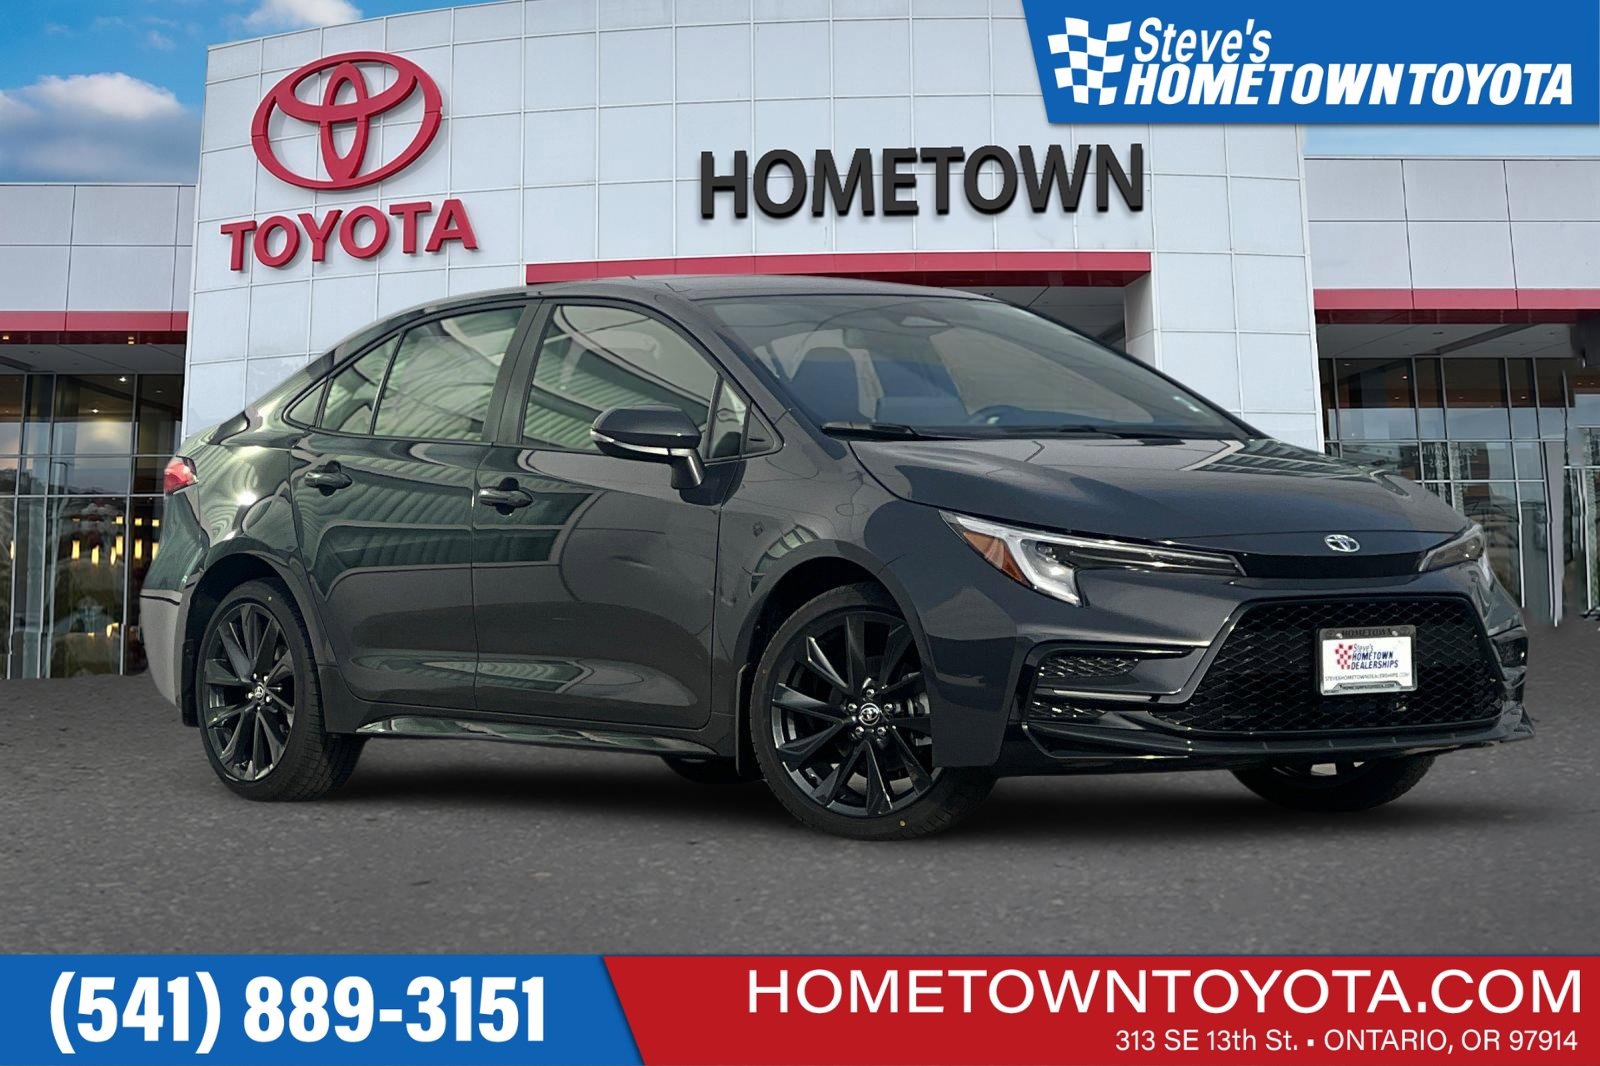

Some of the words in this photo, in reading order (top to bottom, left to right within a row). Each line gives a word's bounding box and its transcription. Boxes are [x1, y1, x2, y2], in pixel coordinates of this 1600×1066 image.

[699, 143, 1145, 219] HOMETOWN
[220, 198, 479, 272] TOYOTA
[1353, 643, 1374, 652] Steve's
[1352, 651, 1394, 660] HOMETOWN
[1351, 660, 1399, 670] DEALERSHIPS
